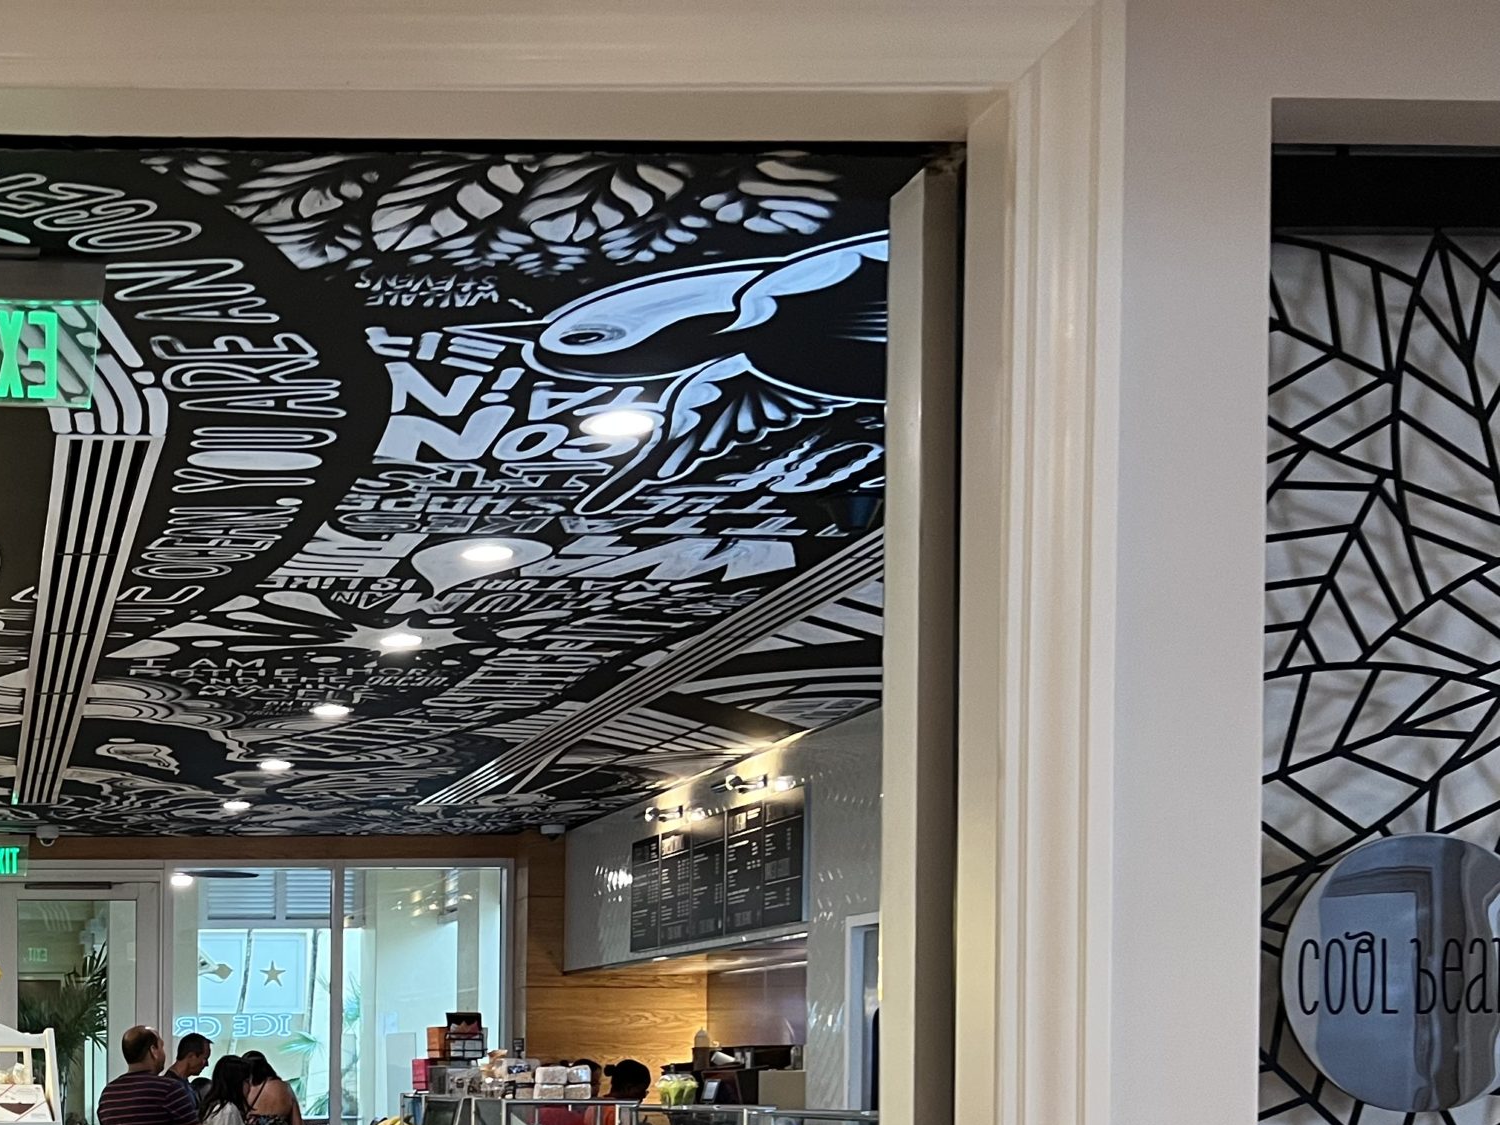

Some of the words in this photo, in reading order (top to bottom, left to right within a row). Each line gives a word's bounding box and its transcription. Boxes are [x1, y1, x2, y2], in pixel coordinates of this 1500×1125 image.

[188, 657, 267, 668] AM
[183, 677, 258, 685] AND
[274, 676, 353, 684] THE
[1298, 931, 1400, 1015] COOL
[1410, 937, 1500, 1015] bea
